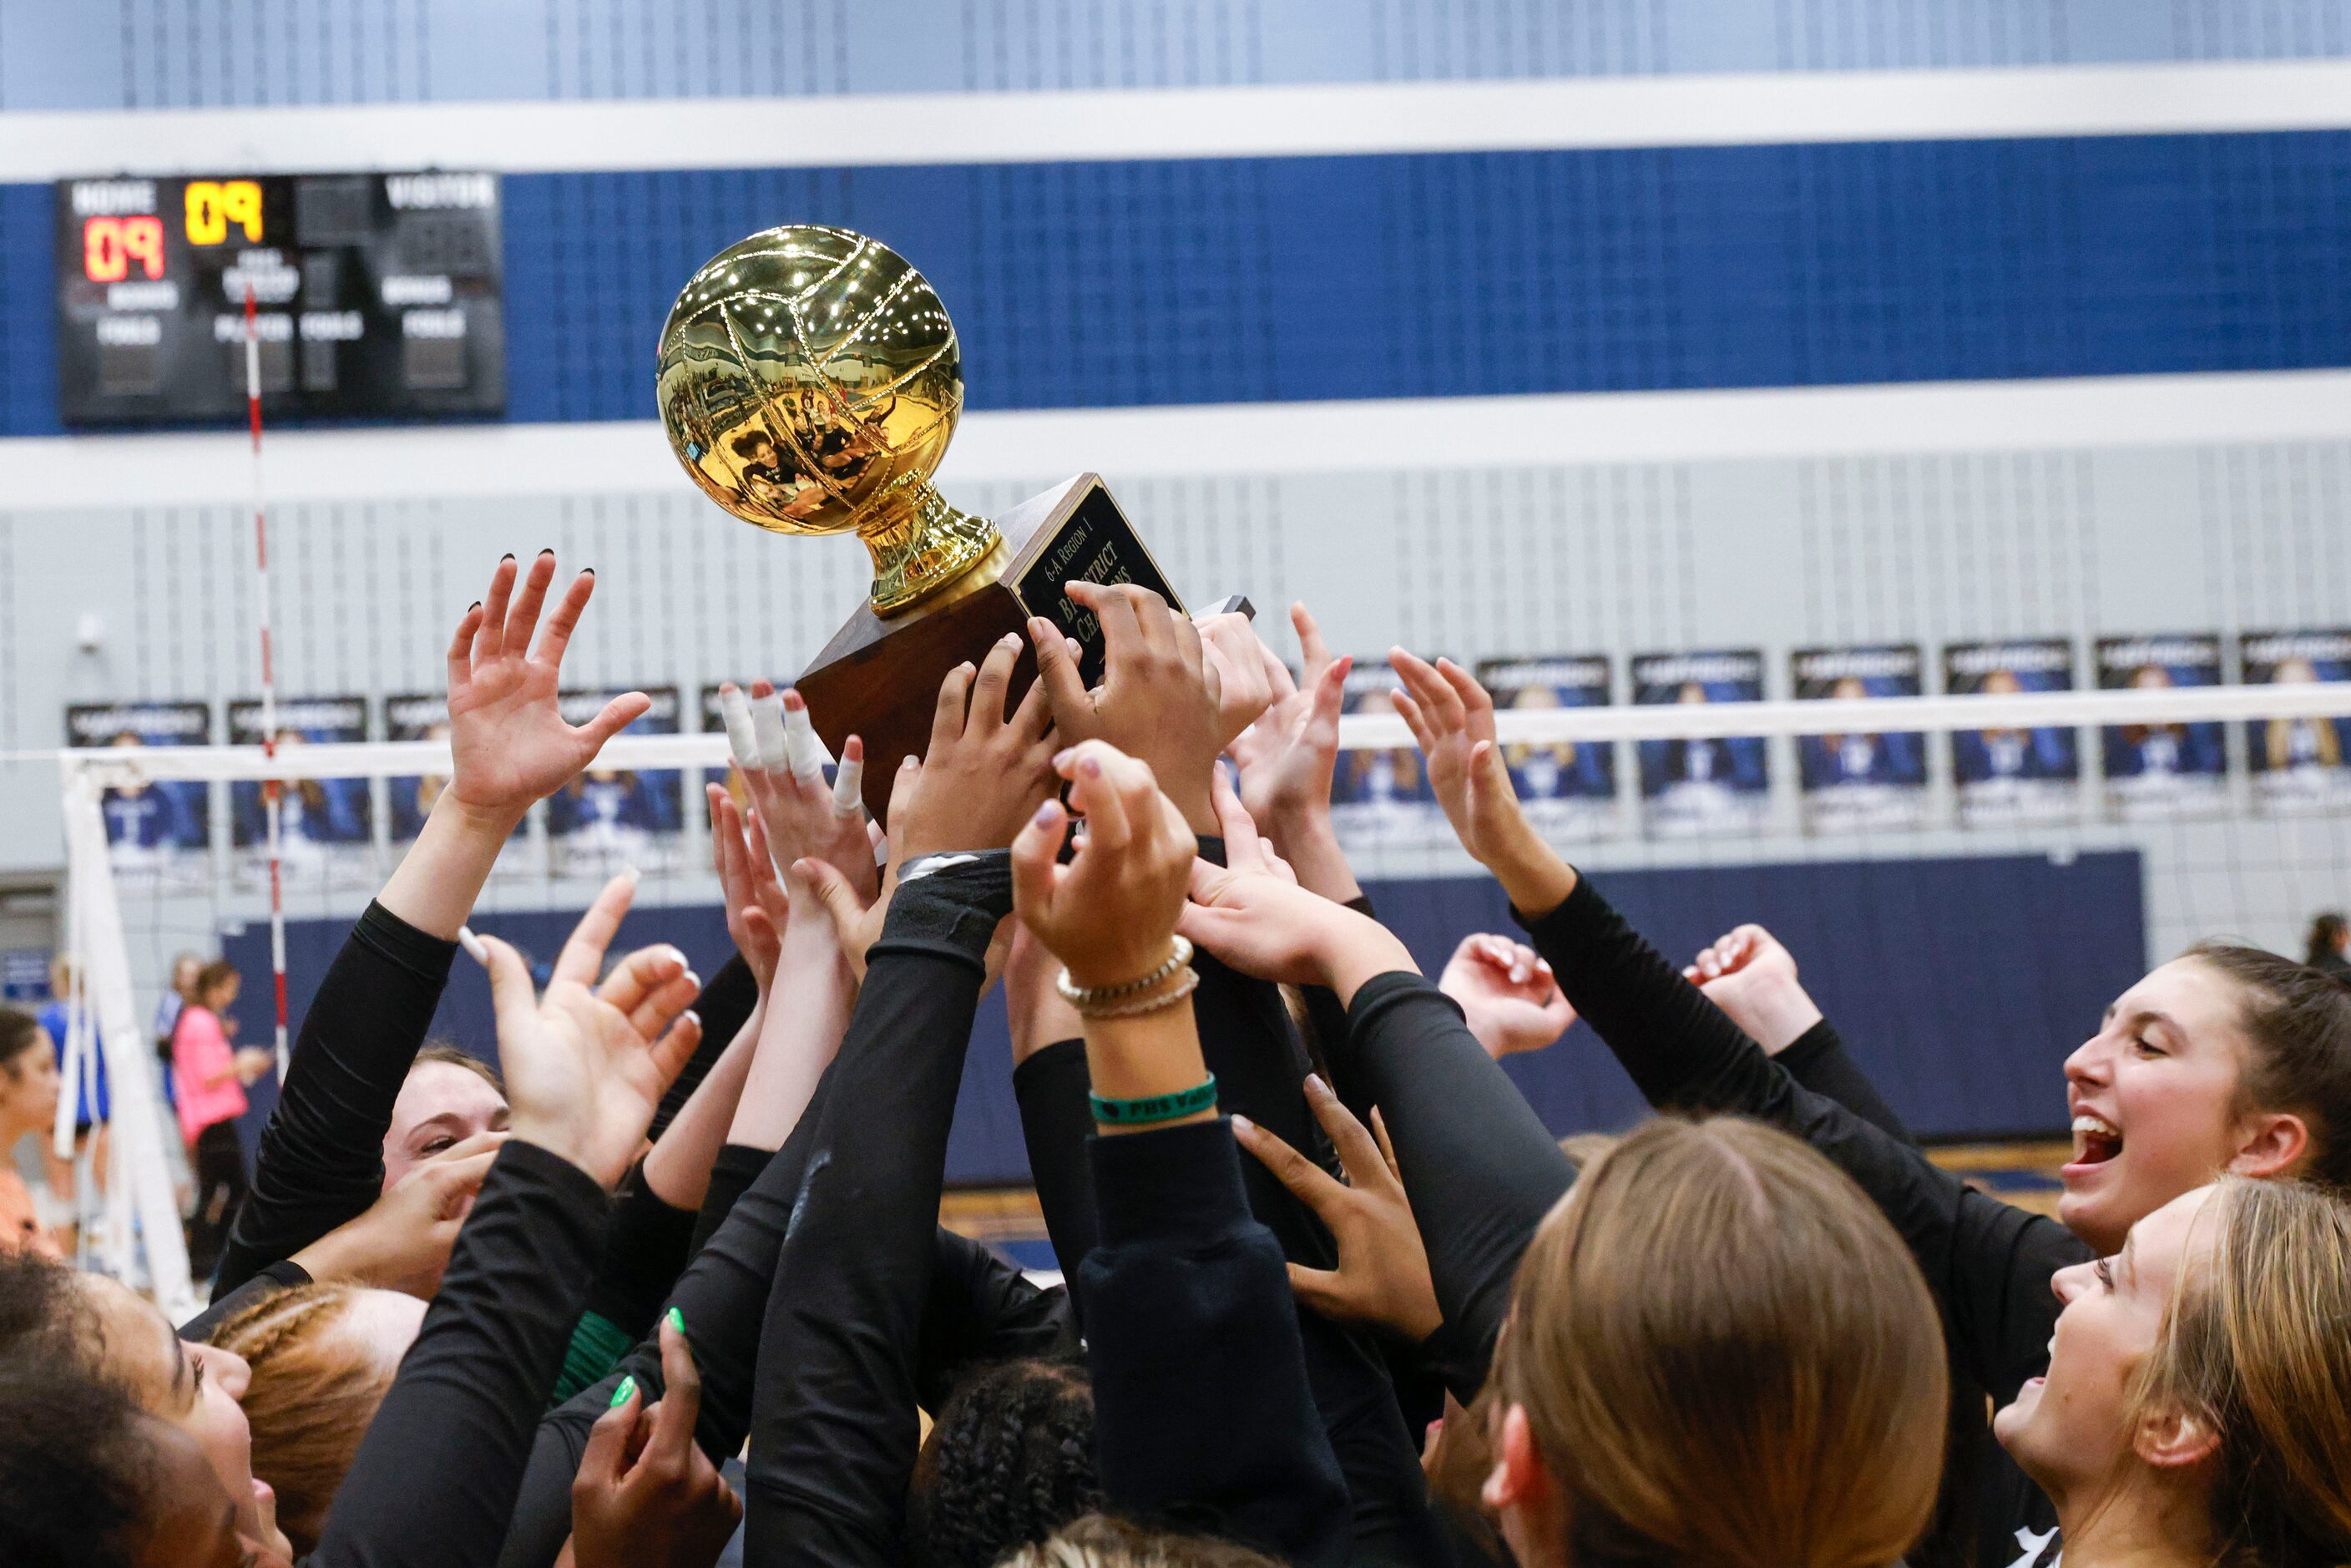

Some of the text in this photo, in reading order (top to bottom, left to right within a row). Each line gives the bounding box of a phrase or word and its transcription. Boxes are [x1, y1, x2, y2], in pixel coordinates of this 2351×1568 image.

[185, 180, 263, 245] 09
[84, 215, 164, 282] 09
[1044, 558, 1063, 582] 6-A
